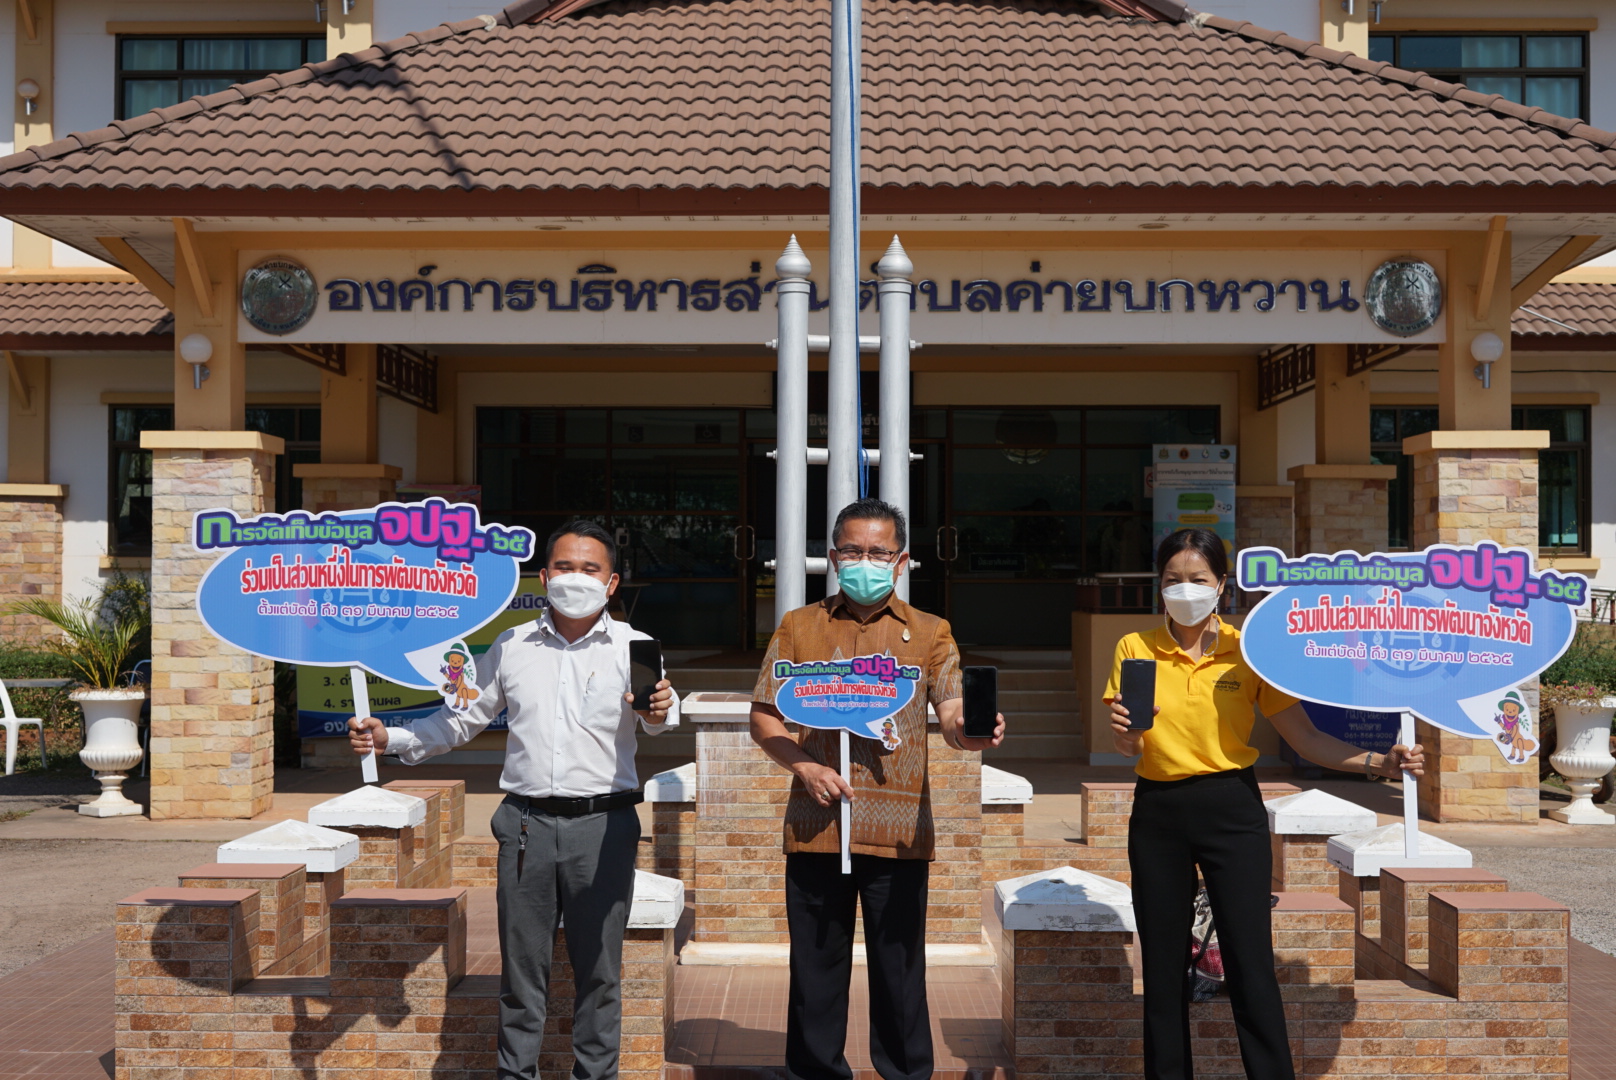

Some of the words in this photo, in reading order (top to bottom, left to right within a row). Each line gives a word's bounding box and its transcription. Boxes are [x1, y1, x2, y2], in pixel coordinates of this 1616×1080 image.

[201, 516, 373, 544] การจัดเก็บข้อมูล
[241, 546, 478, 597] ร่วมเป็นส่วนหนึ่งในการพัฒนาจังหวัด
[1247, 555, 1424, 587] การจัดเก็บข้อมูล
[257, 599, 318, 616] ตั้งแต่บัดนี้
[321, 601, 338, 617] ถึง
[367, 604, 411, 618] มีนาคม
[415, 606, 460, 619] ๒๕๖๕
[1287, 588, 1533, 645] ร่วมเป็นส่วนหนึ่งในการพัฒนาจังหวัด
[1304, 640, 1368, 659] ตั้งแต่บัดนี้
[1371, 644, 1388, 661] ถึง
[1418, 648, 1464, 663] มีนาคม
[1468, 651, 1514, 665] ๒๕๖๕
[340, 696, 402, 709] ราานผล
